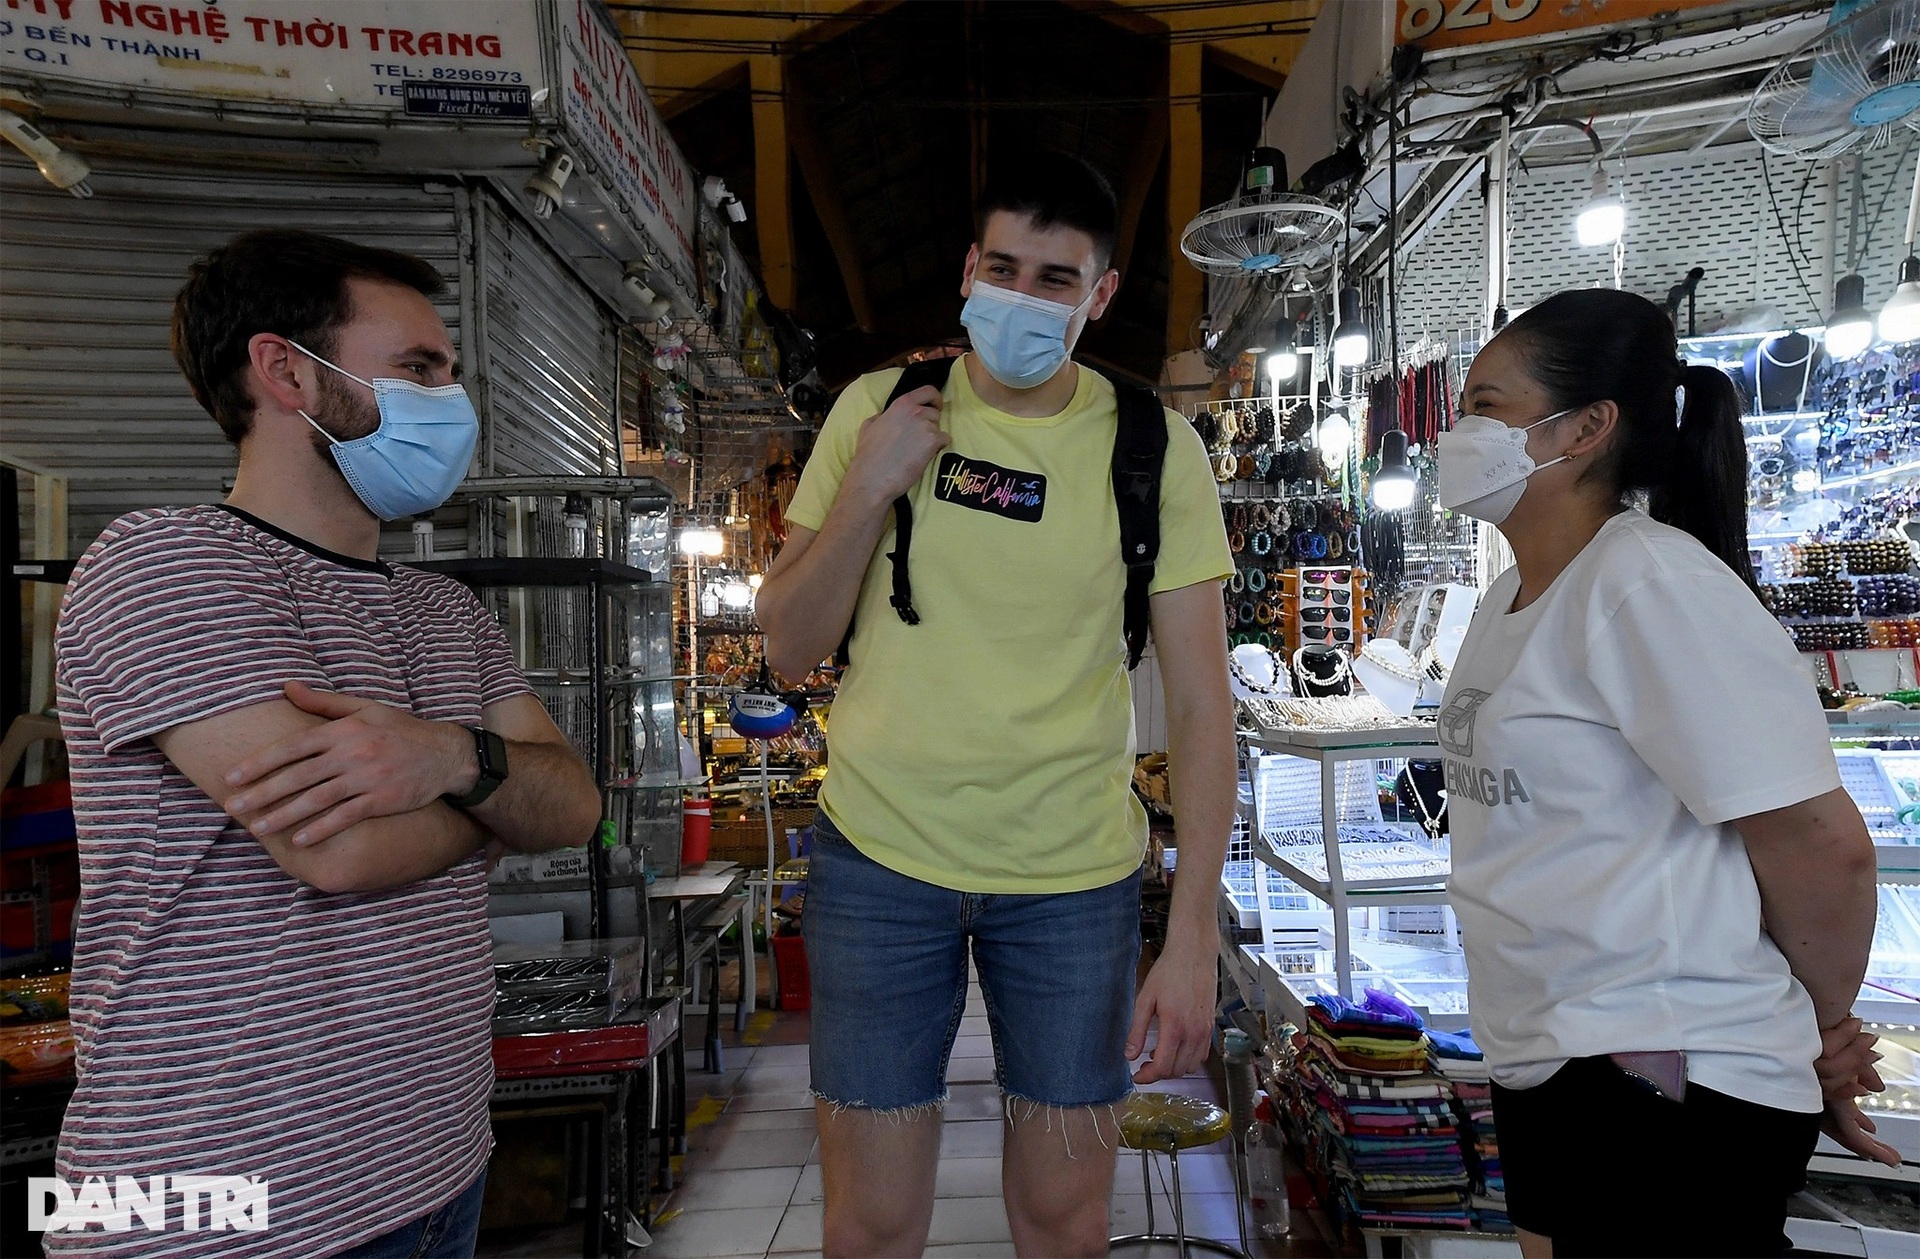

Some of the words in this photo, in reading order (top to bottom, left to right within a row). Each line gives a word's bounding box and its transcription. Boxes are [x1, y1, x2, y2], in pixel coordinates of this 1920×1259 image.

[25, 25, 91, 47] BẾN
[100, 36, 200, 60] THÀNH
[100, 0, 229, 43] NGHỆ
[244, 17, 348, 49] THỜI
[361, 27, 500, 58] TRANG
[370, 64, 423, 78] TEL:
[432, 67, 522, 83] 8296973
[438, 102, 469, 114] Fixed
[471, 104, 501, 115] Price
[941, 460, 988, 499] Hollister
[982, 471, 1041, 508] California
